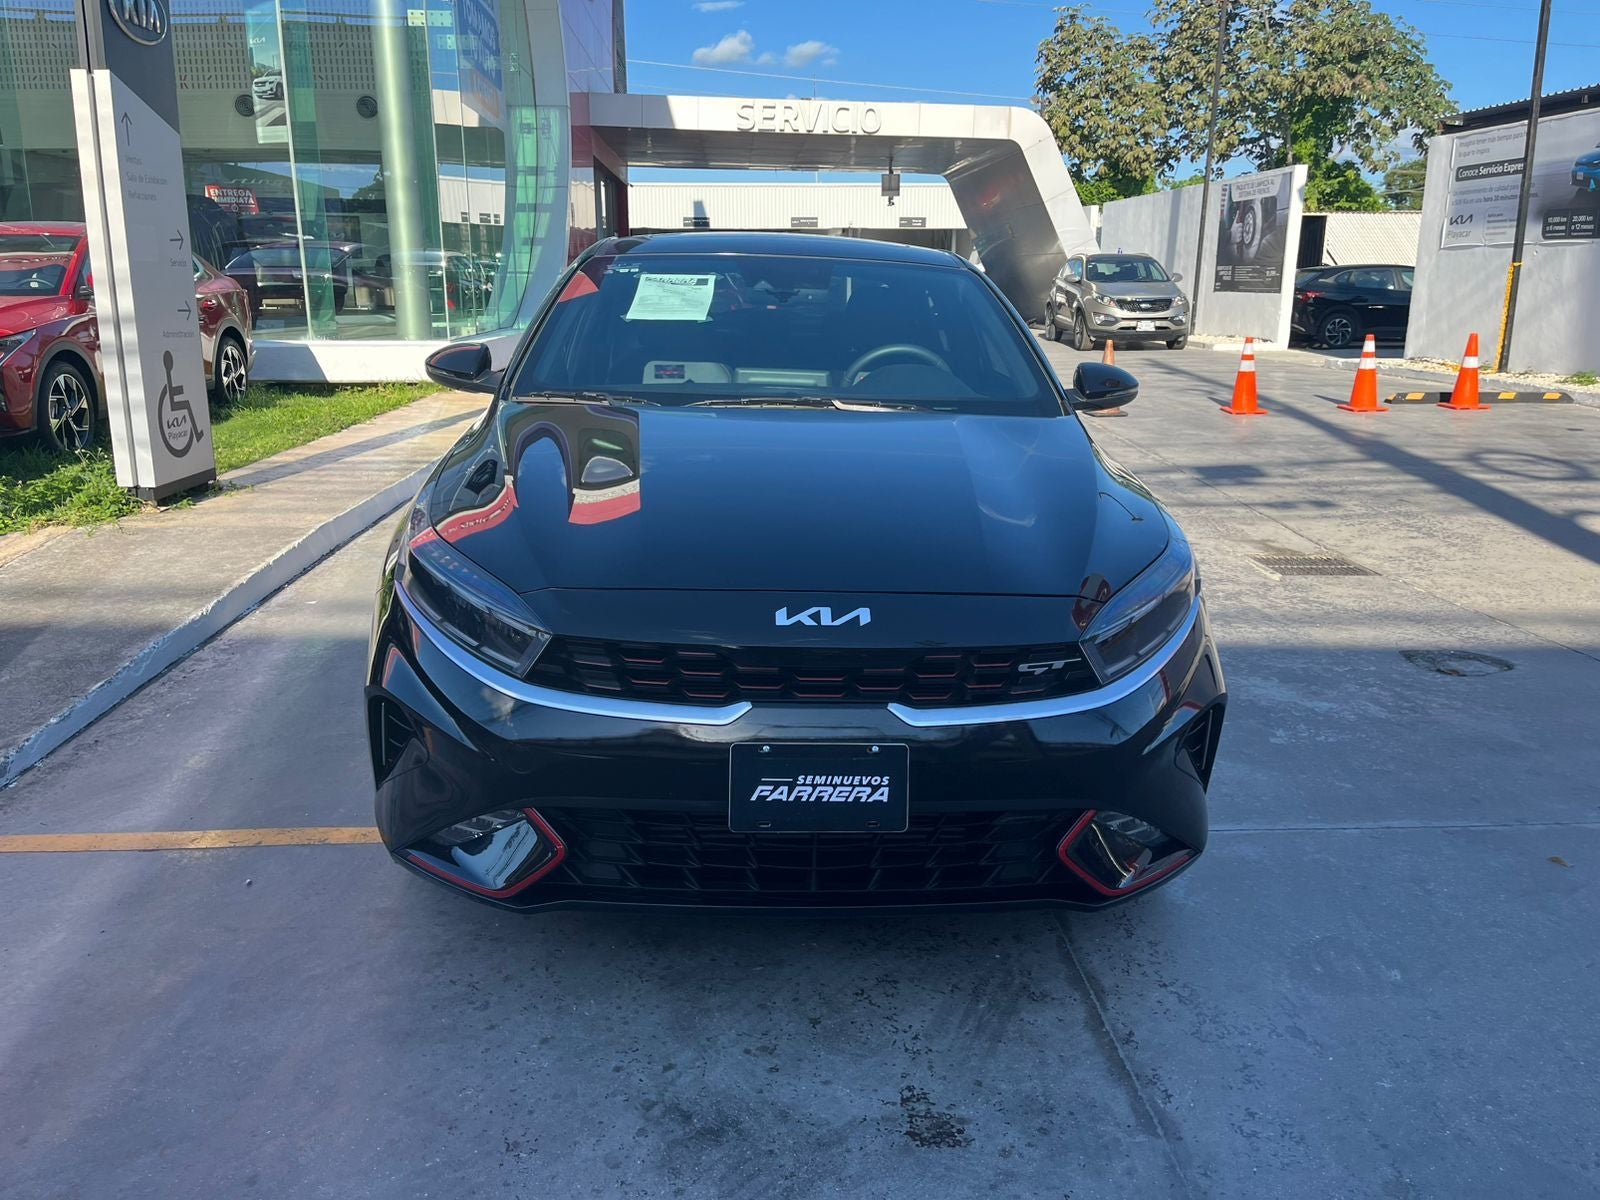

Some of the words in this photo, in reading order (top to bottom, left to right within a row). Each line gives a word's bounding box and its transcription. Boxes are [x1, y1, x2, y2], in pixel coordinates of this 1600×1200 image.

[736, 104, 881, 135] SERVICIO
[1458, 168, 1479, 179] Conoce
[1479, 165, 1503, 176] Servicio
[209, 188, 252, 197] ENTREGA
[1449, 213, 1474, 226] KIA
[166, 414, 187, 429] KIA
[775, 606, 871, 627] KIA
[1018, 658, 1081, 675] GT
[797, 775, 890, 785] SEMINUEVOS
[749, 785, 890, 803] FARRERA
